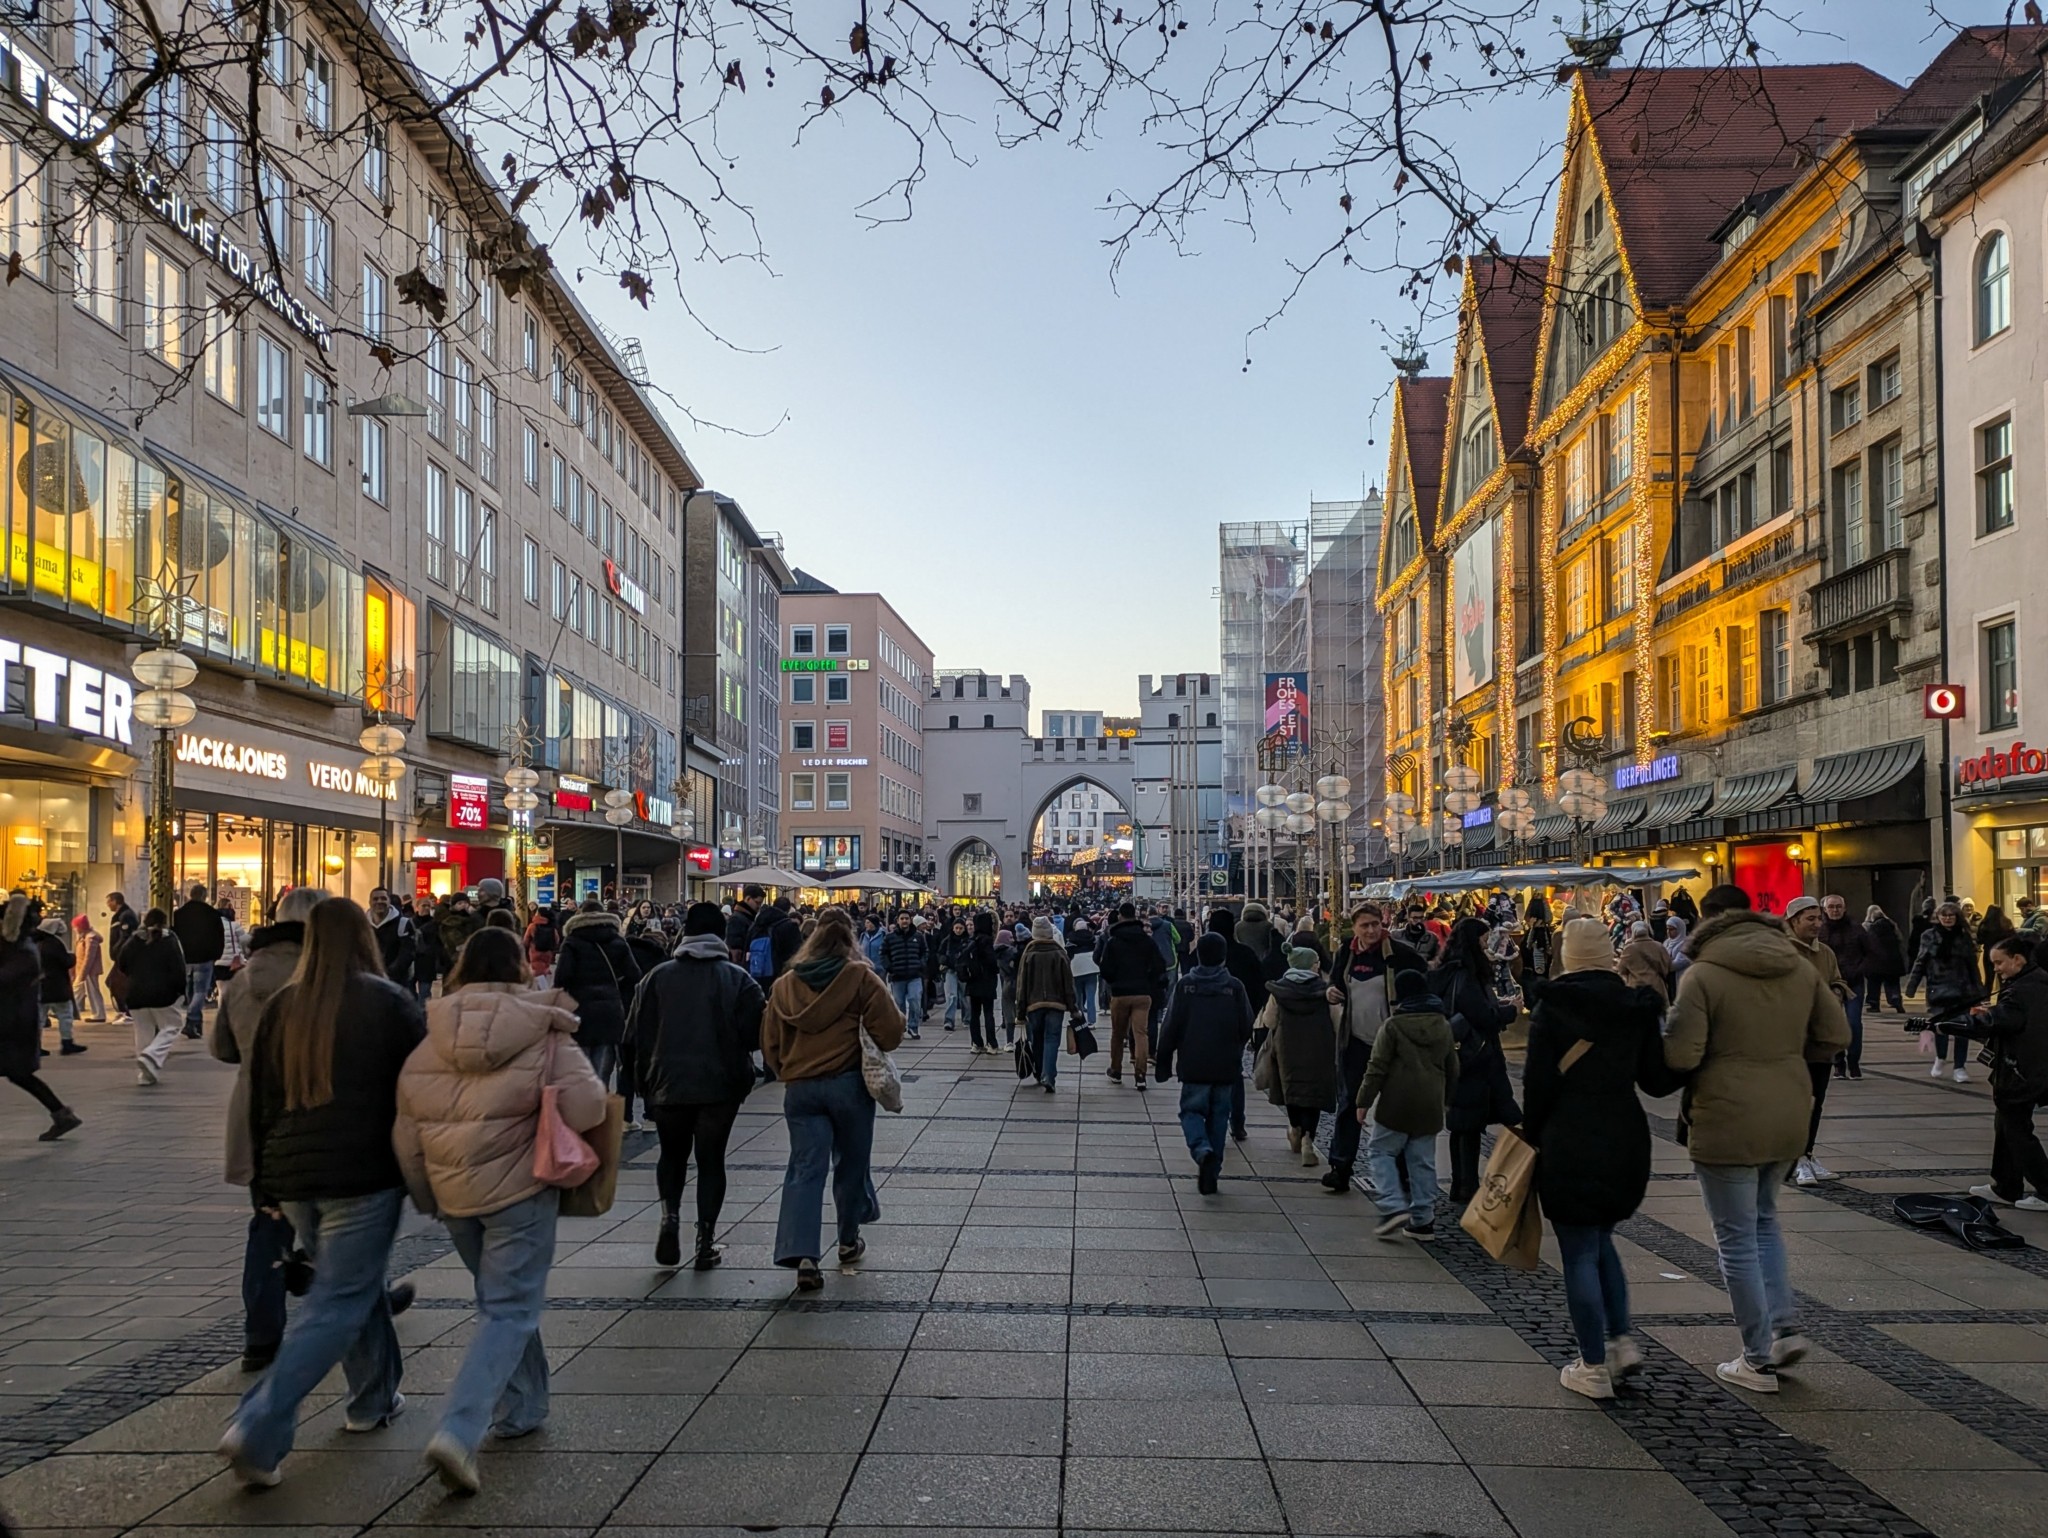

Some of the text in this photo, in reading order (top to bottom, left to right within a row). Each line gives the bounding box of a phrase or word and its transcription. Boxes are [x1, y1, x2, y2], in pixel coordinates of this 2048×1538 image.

[14, 545, 58, 574] Paama
[781, 659, 837, 671] EVERGREEN
[1279, 677, 1296, 688] FR
[1277, 688, 1297, 699] OH
[1279, 699, 1296, 710] ES
[1280, 714, 1296, 725] FE
[1280, 726, 1296, 736] ST
[176, 733, 287, 780] JACK&JONES
[310, 762, 352, 793] VERO
[836, 758, 868, 766] FISCHER
[1959, 741, 2048, 784] vodafo
[1616, 755, 1677, 791] OBERPOLLINGER
[560, 776, 588, 793] Restaurant
[456, 806, 482, 822] -70%
[649, 796, 672, 827] SATURN
[1214, 854, 1225, 868] U
[1215, 871, 1225, 884] S
[218, 890, 248, 900] SALE
[1757, 891, 1780, 909] 30%
